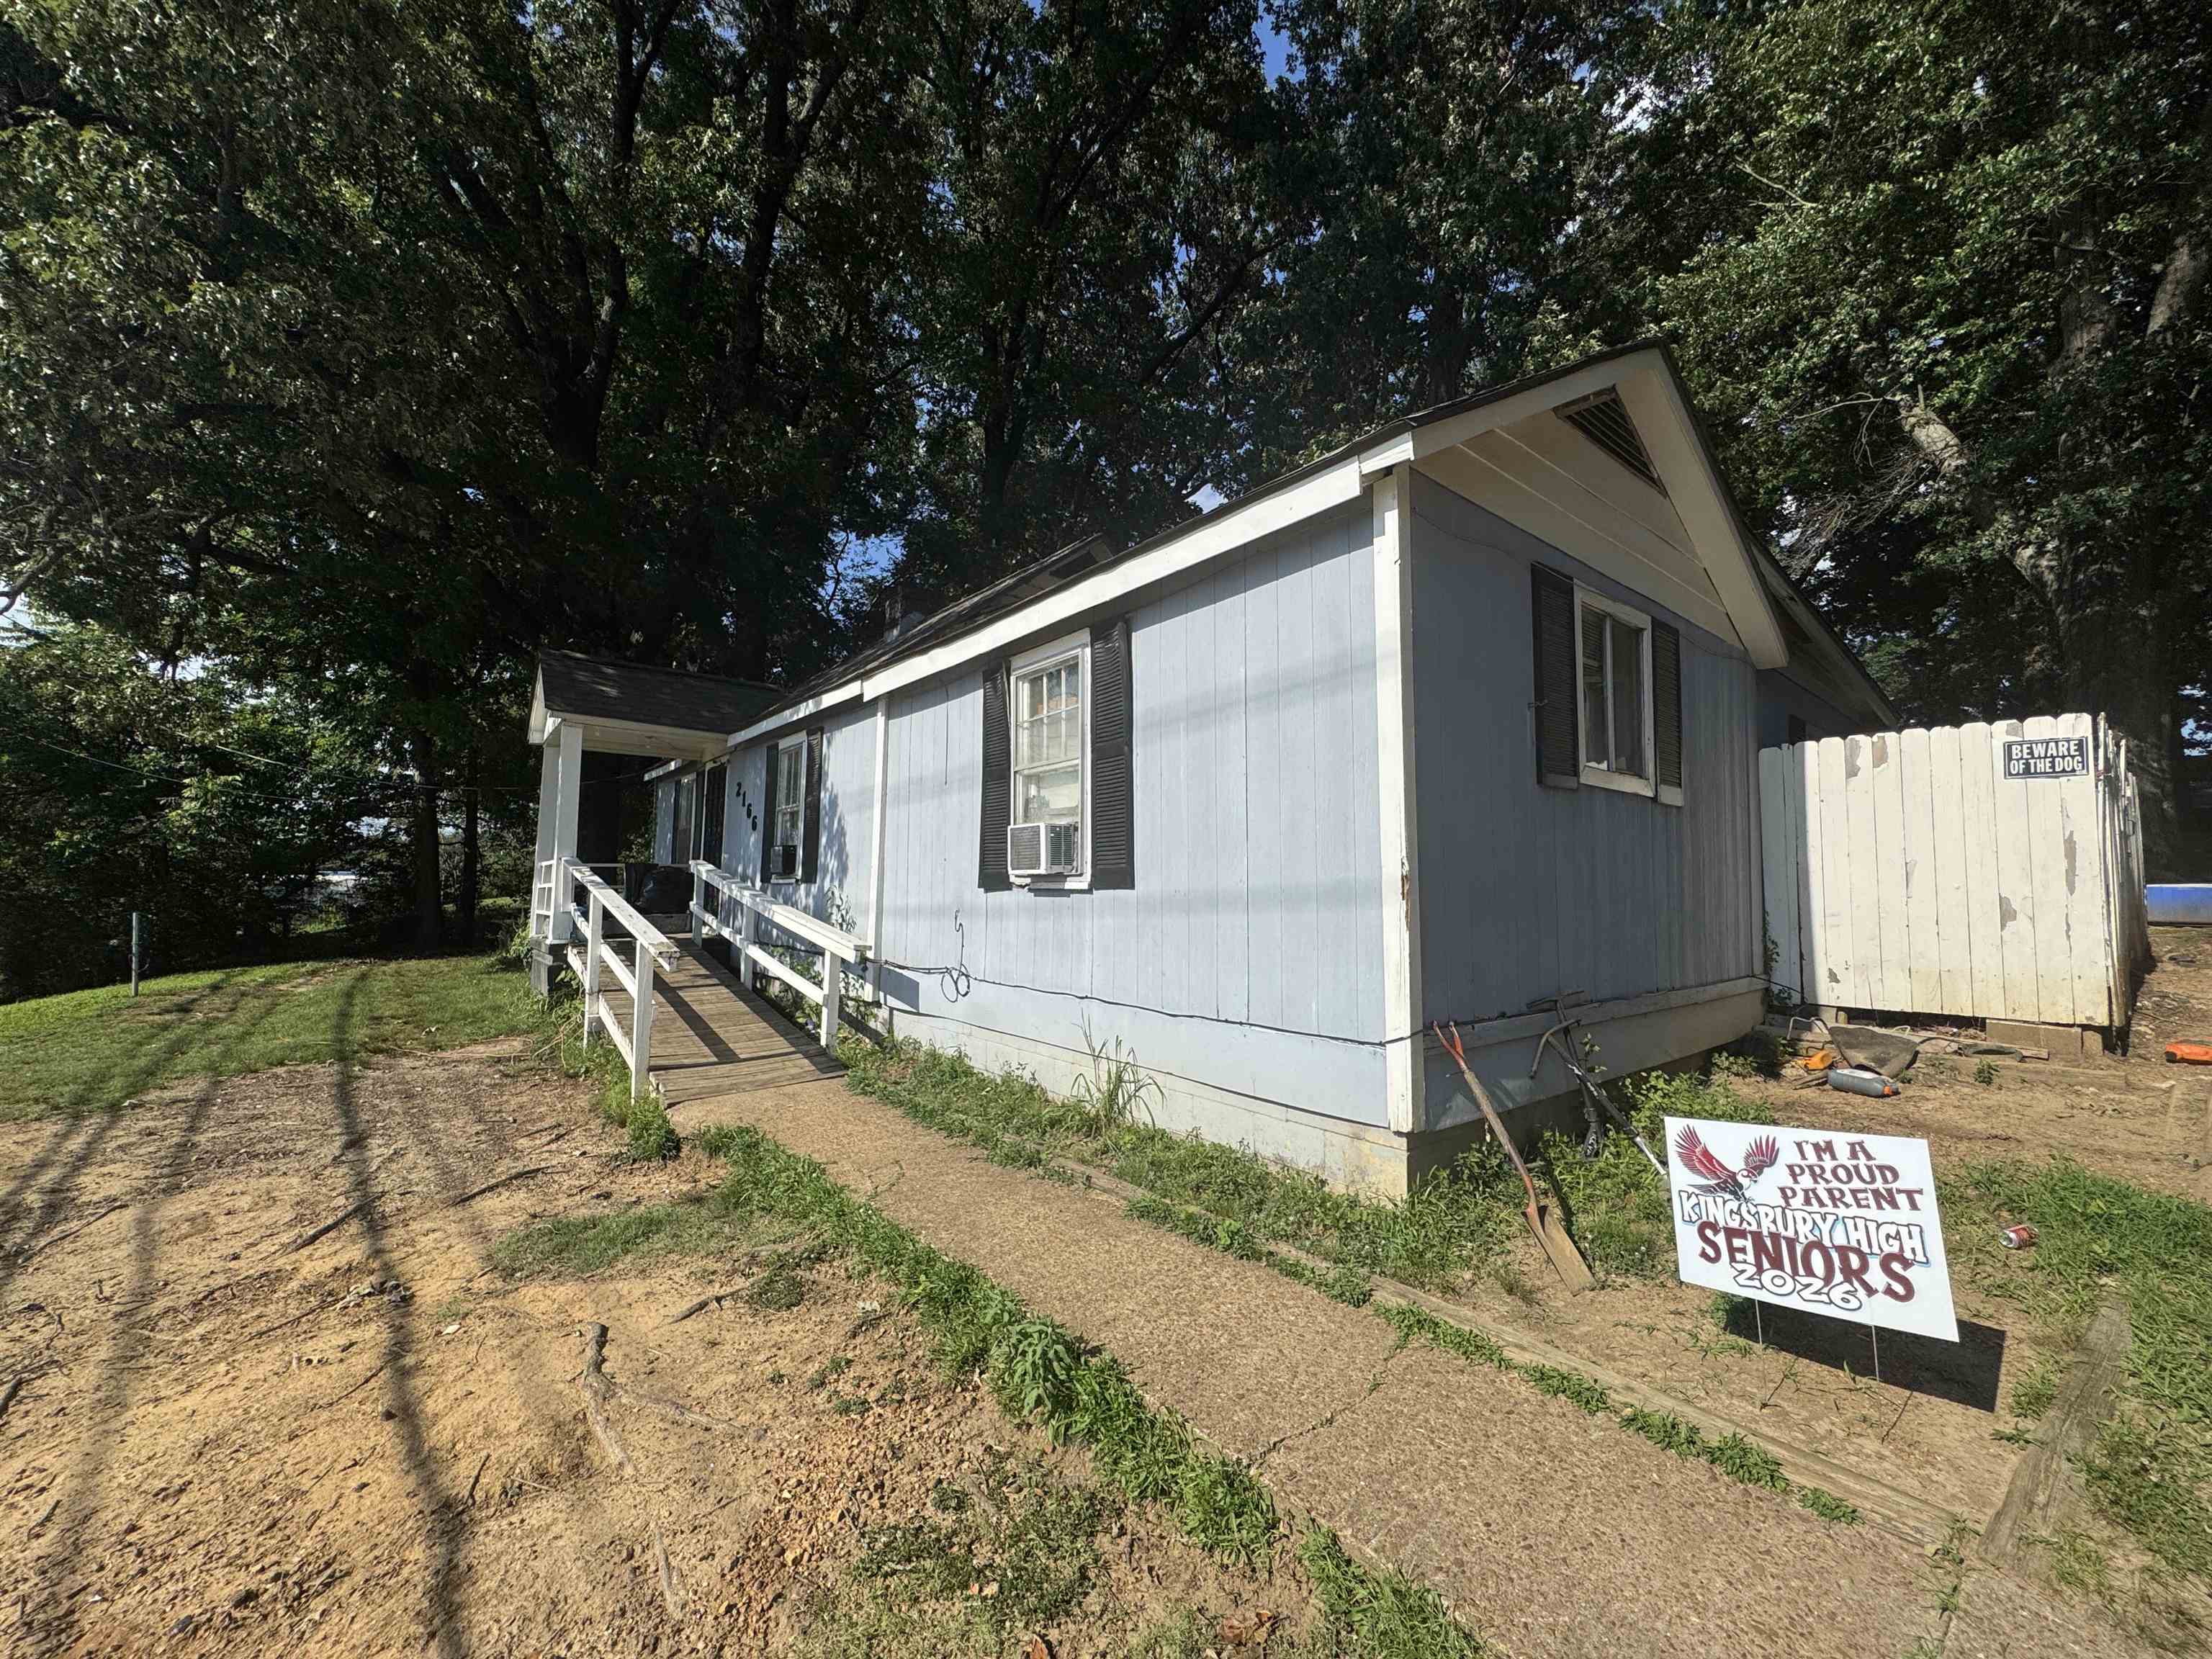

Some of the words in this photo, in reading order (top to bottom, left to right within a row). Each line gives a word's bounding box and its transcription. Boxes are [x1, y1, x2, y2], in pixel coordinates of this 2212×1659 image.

[2011, 740, 2080, 759] BEWARE
[2010, 760, 2026, 774] OF
[2028, 758, 2052, 773] THE
[2054, 756, 2082, 772] DOG
[736, 781, 757, 831] 2166
[1794, 1139, 1840, 1161] I'M
[1846, 1139, 1876, 1161] A
[1785, 1163, 1899, 1186] PROUD
[1777, 1187, 1923, 1211] PARENT
[1678, 1190, 1838, 1248] KINGSBURY
[1843, 1216, 1929, 1264] HIGH
[1697, 1220, 1915, 1303] SENIORS
[1730, 1262, 1863, 1311] 2026
